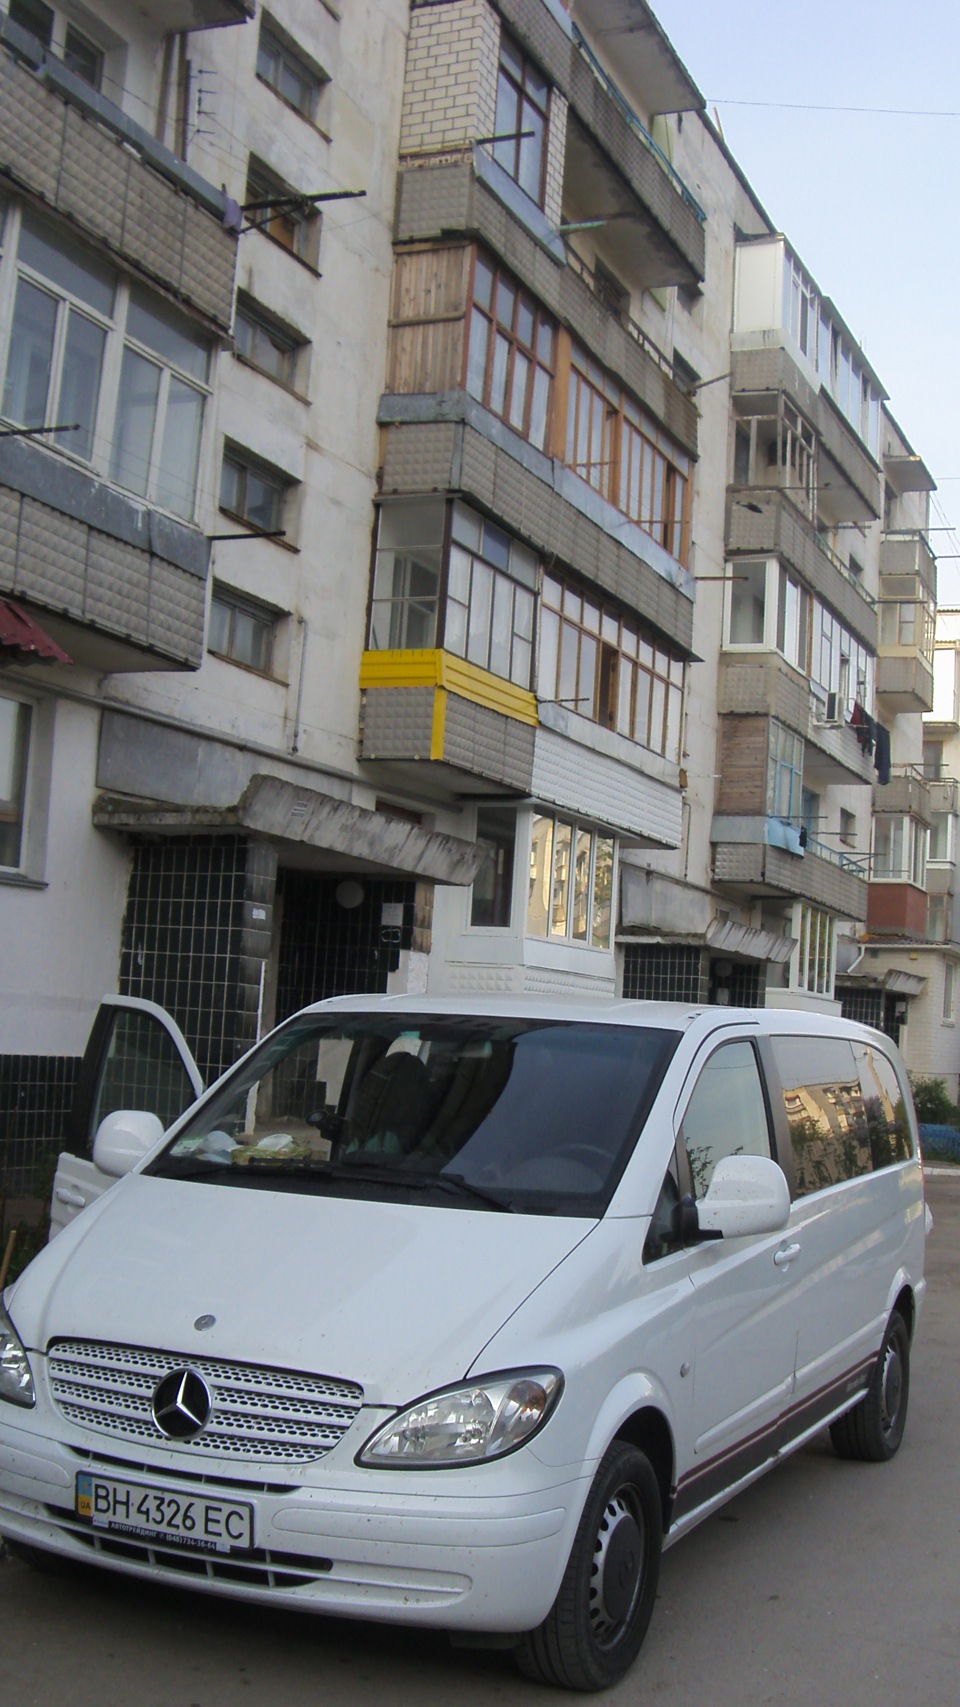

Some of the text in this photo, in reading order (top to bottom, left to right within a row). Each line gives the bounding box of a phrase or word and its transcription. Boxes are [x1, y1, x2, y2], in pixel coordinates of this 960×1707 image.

[80, 1501, 92, 1511] UA
[94, 1483, 245, 1540] BH 4326 EC
